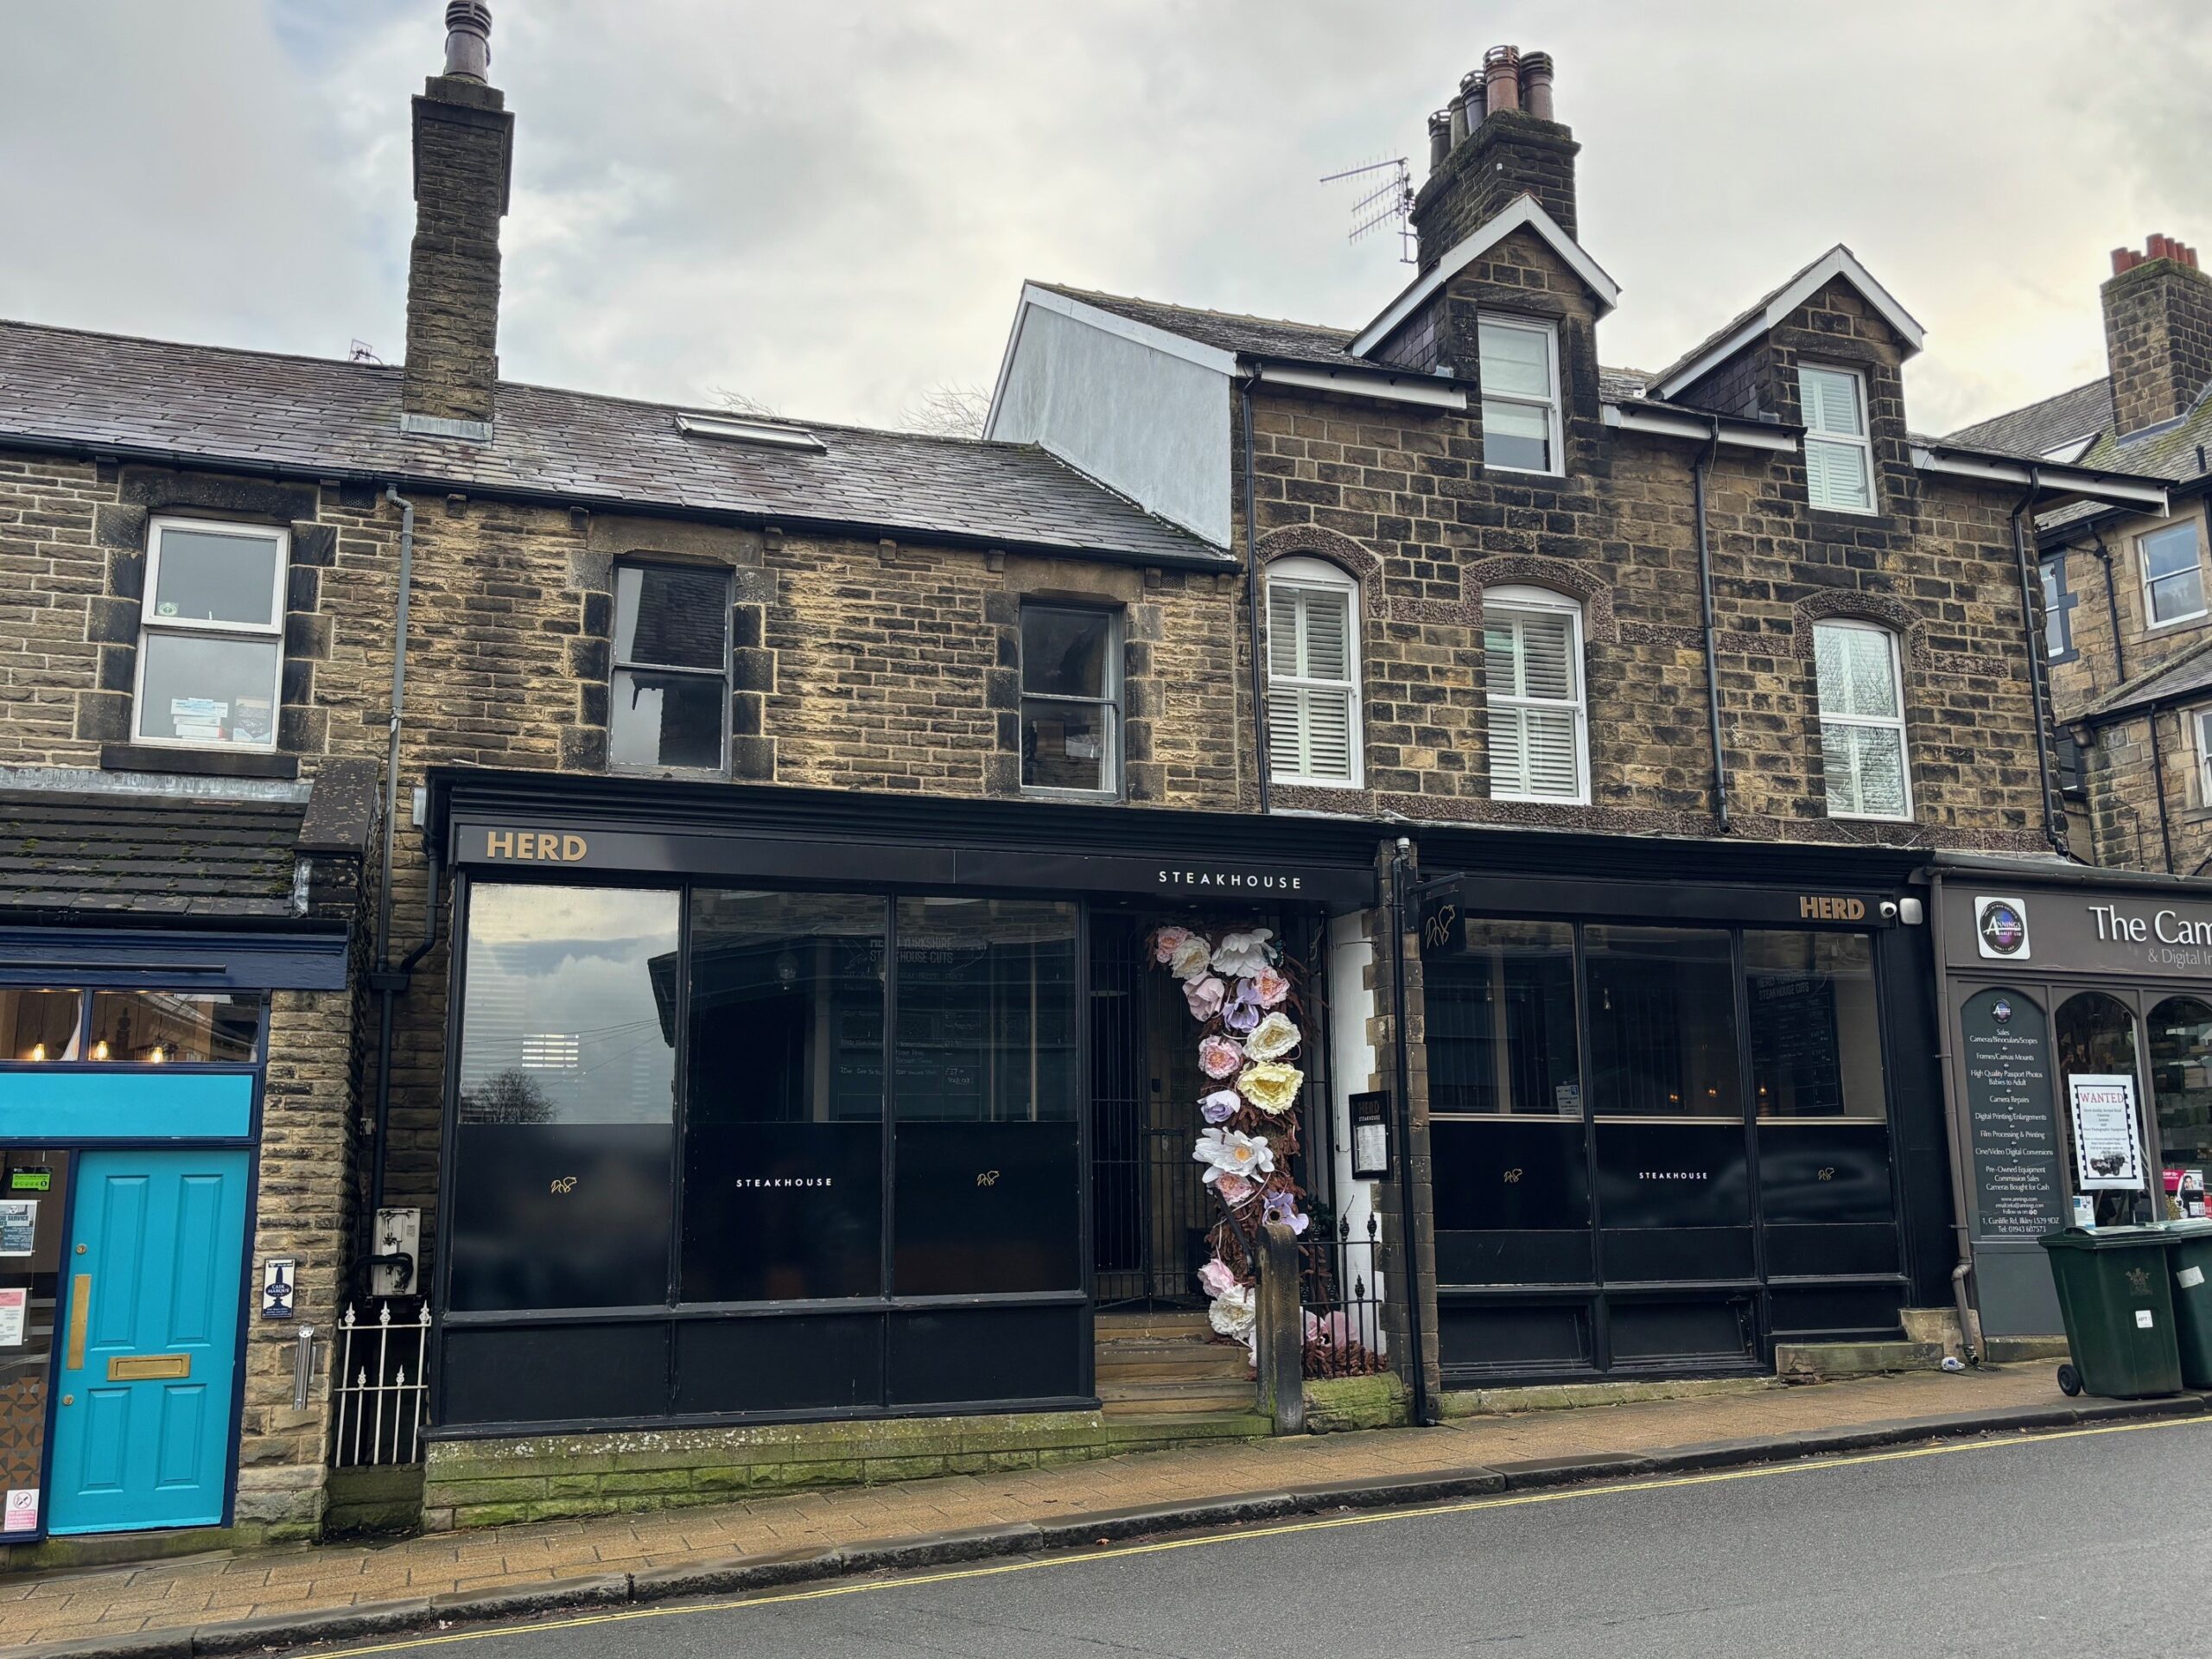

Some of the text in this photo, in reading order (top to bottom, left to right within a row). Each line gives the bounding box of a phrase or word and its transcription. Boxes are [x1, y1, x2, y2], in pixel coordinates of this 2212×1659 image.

[486, 830, 588, 861] HERD
[1159, 871, 1300, 889] STEAKHOUSE
[1800, 896, 1866, 920] HERD
[2088, 905, 2147, 942] The
[930, 951, 953, 964] CUTS
[2148, 948, 2158, 963] &
[2161, 949, 2200, 969] Digital
[1970, 1036, 2037, 1046] Cameras/Binoculars/Scopes
[1976, 1052, 2014, 1061] Frames/Canvas
[1971, 1070, 1984, 1078] High
[1985, 1070, 2003, 1078] Quality
[2004, 1071, 2024, 1079] Passport
[2011, 1096, 2030, 1104] Repairs
[2080, 1093, 2125, 1103] WANTED
[1358, 1101, 1380, 1115] HERD
[1975, 1112, 2047, 1122] Digital Printing/Enlargements
[1993, 1130, 2019, 1140] Processing
[2025, 1131, 2045, 1140] Printing
[2005, 1148, 2022, 1157] Digital
[2018, 1166, 2046, 1175] Equipment
[736, 1178, 832, 1187] STEAKHOUSE
[2009, 1184, 2028, 1192] Bought
[2019, 1217, 2032, 1226] Ilkley
